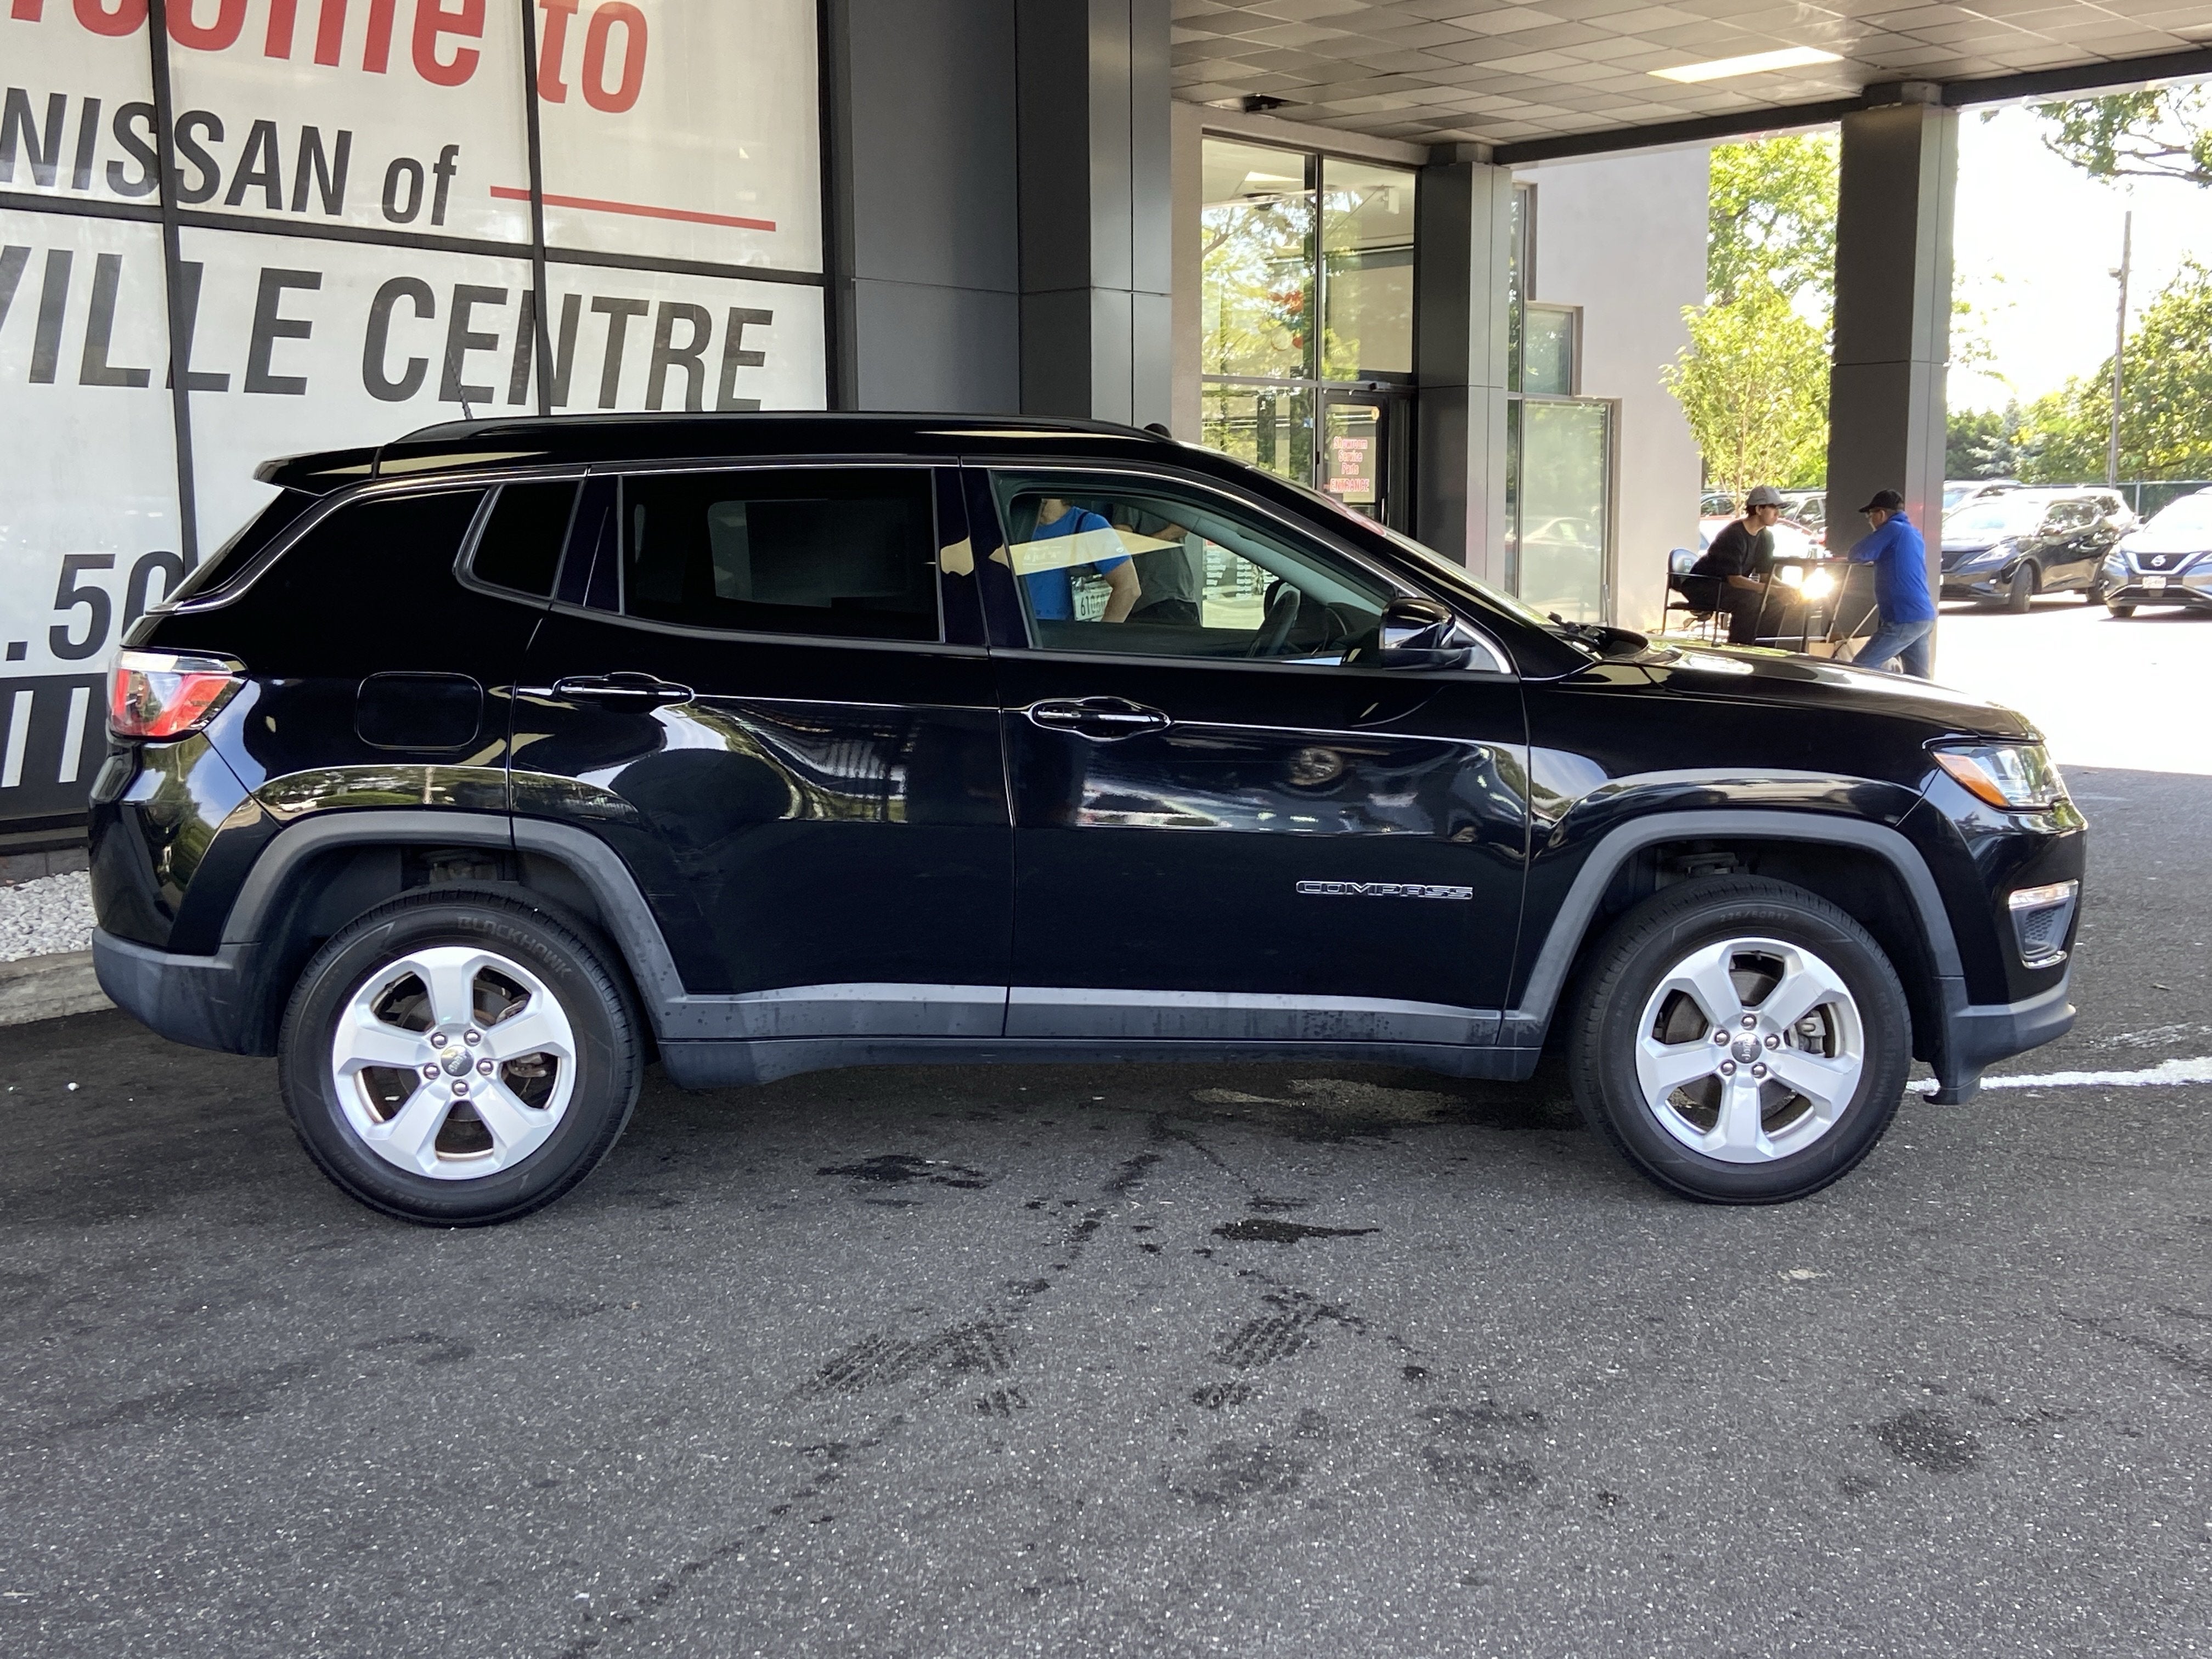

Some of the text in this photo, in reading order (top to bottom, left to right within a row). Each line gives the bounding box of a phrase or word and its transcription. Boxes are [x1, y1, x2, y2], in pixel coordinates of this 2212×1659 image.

[537, 0, 648, 114] to
[0, 87, 459, 225] NISSAN of
[362, 276, 774, 413] CENTRE
[1338, 449, 1363, 462] Service
[1341, 462, 1359, 475] Parts
[1330, 478, 1370, 492] ENTRANCE
[1296, 881, 1473, 900] COMPASS
[458, 917, 572, 978] BLACKHAWK
